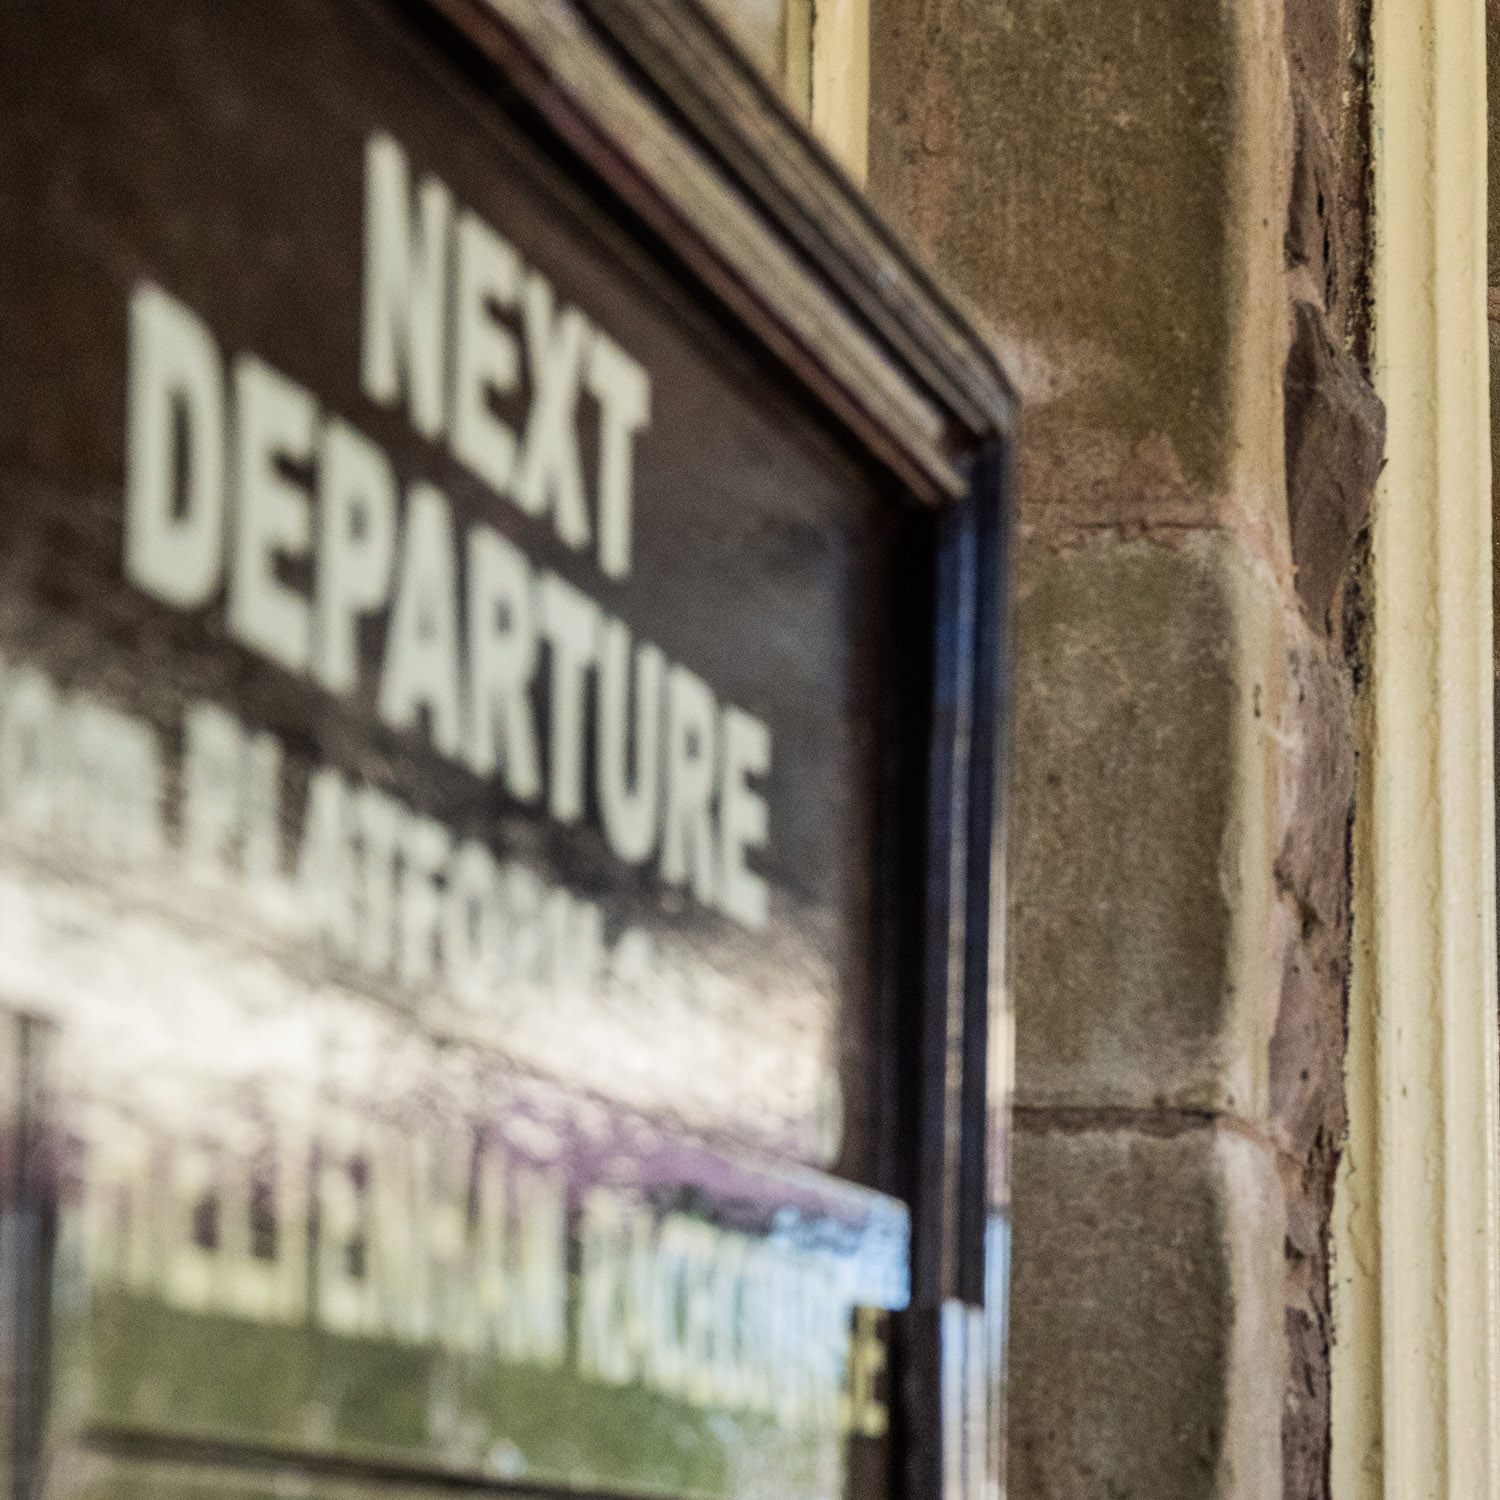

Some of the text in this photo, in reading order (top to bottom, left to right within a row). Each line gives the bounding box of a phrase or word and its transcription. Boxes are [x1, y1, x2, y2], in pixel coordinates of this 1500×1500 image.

[361, 128, 653, 582] NEXT
[124, 277, 772, 932] DEPARTURE
[183, 697, 605, 1010] PLATFORM
